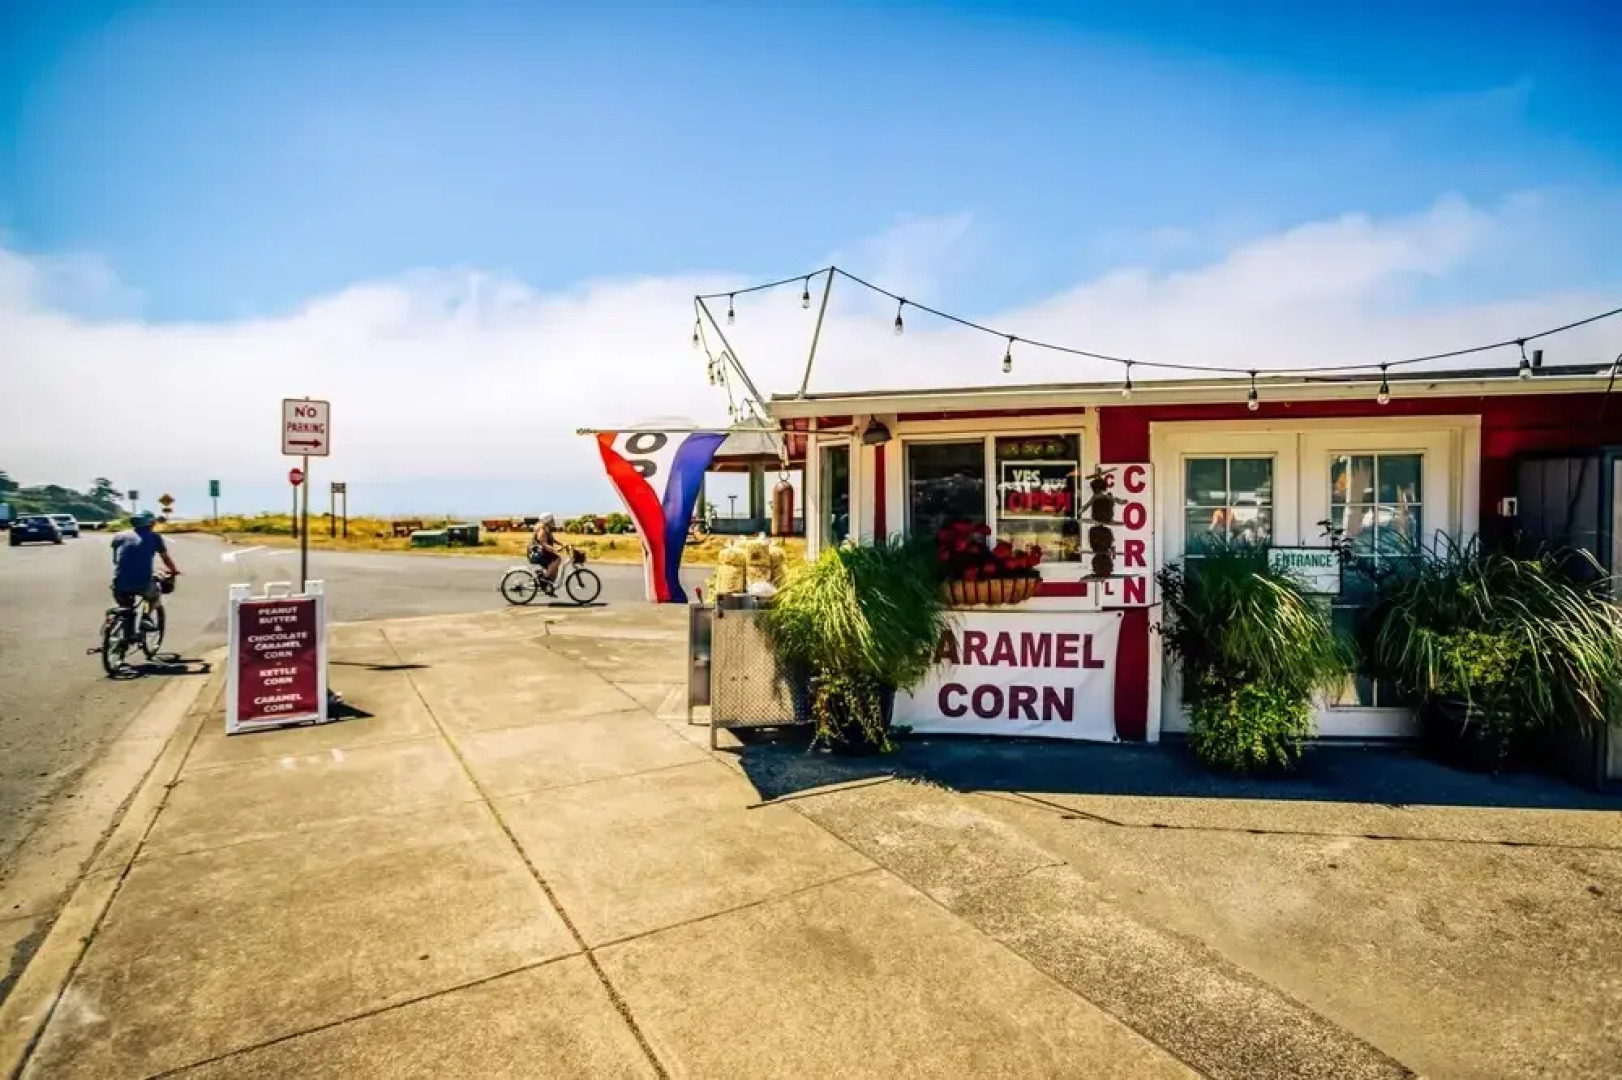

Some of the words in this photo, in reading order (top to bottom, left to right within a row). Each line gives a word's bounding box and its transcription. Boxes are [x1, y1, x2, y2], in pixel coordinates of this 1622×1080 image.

[295, 407, 317, 418] NO
[287, 422, 325, 434] PARKING
[1123, 465, 1148, 604] CORN
[1275, 553, 1332, 567] ENTRANCE
[258, 606, 298, 615] PEANUT
[259, 615, 297, 624] BUTTER
[248, 632, 308, 643] CHOCOLATE
[254, 641, 302, 650] CARAMEL
[933, 630, 1105, 669] ARAMEL
[264, 650, 293, 659] CORN
[259, 667, 297, 677] KETTLE
[264, 677, 293, 686] CORN
[254, 693, 303, 704] CARAMEL
[938, 683, 1075, 722] CORN
[264, 703, 293, 713] CORN
